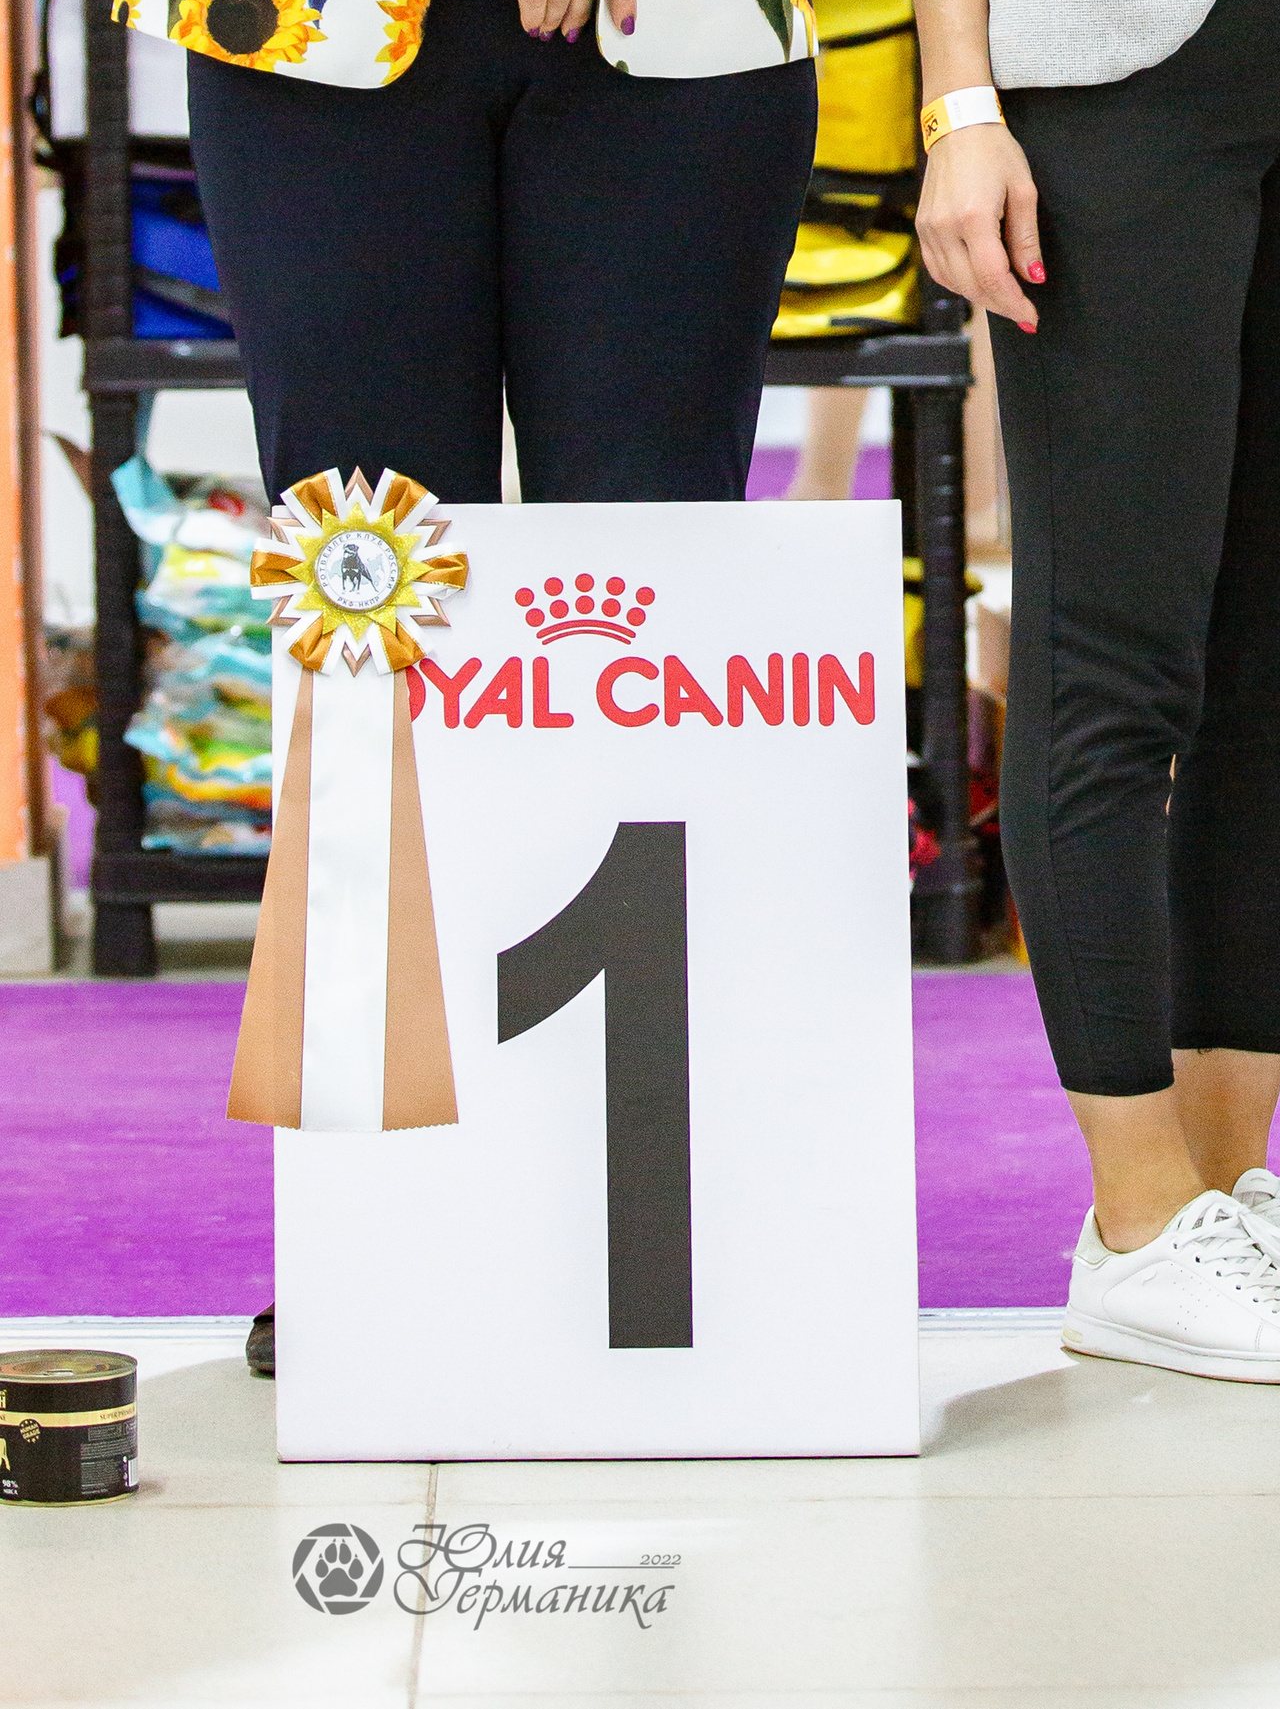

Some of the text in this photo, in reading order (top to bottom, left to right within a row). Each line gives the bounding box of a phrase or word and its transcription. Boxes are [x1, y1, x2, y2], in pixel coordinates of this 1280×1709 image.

[356, 532, 384, 547] КЛУБ
[384, 548, 398, 590] РОССИИ
[596, 652, 876, 728] CANIN
[497, 821, 694, 1349] 1
